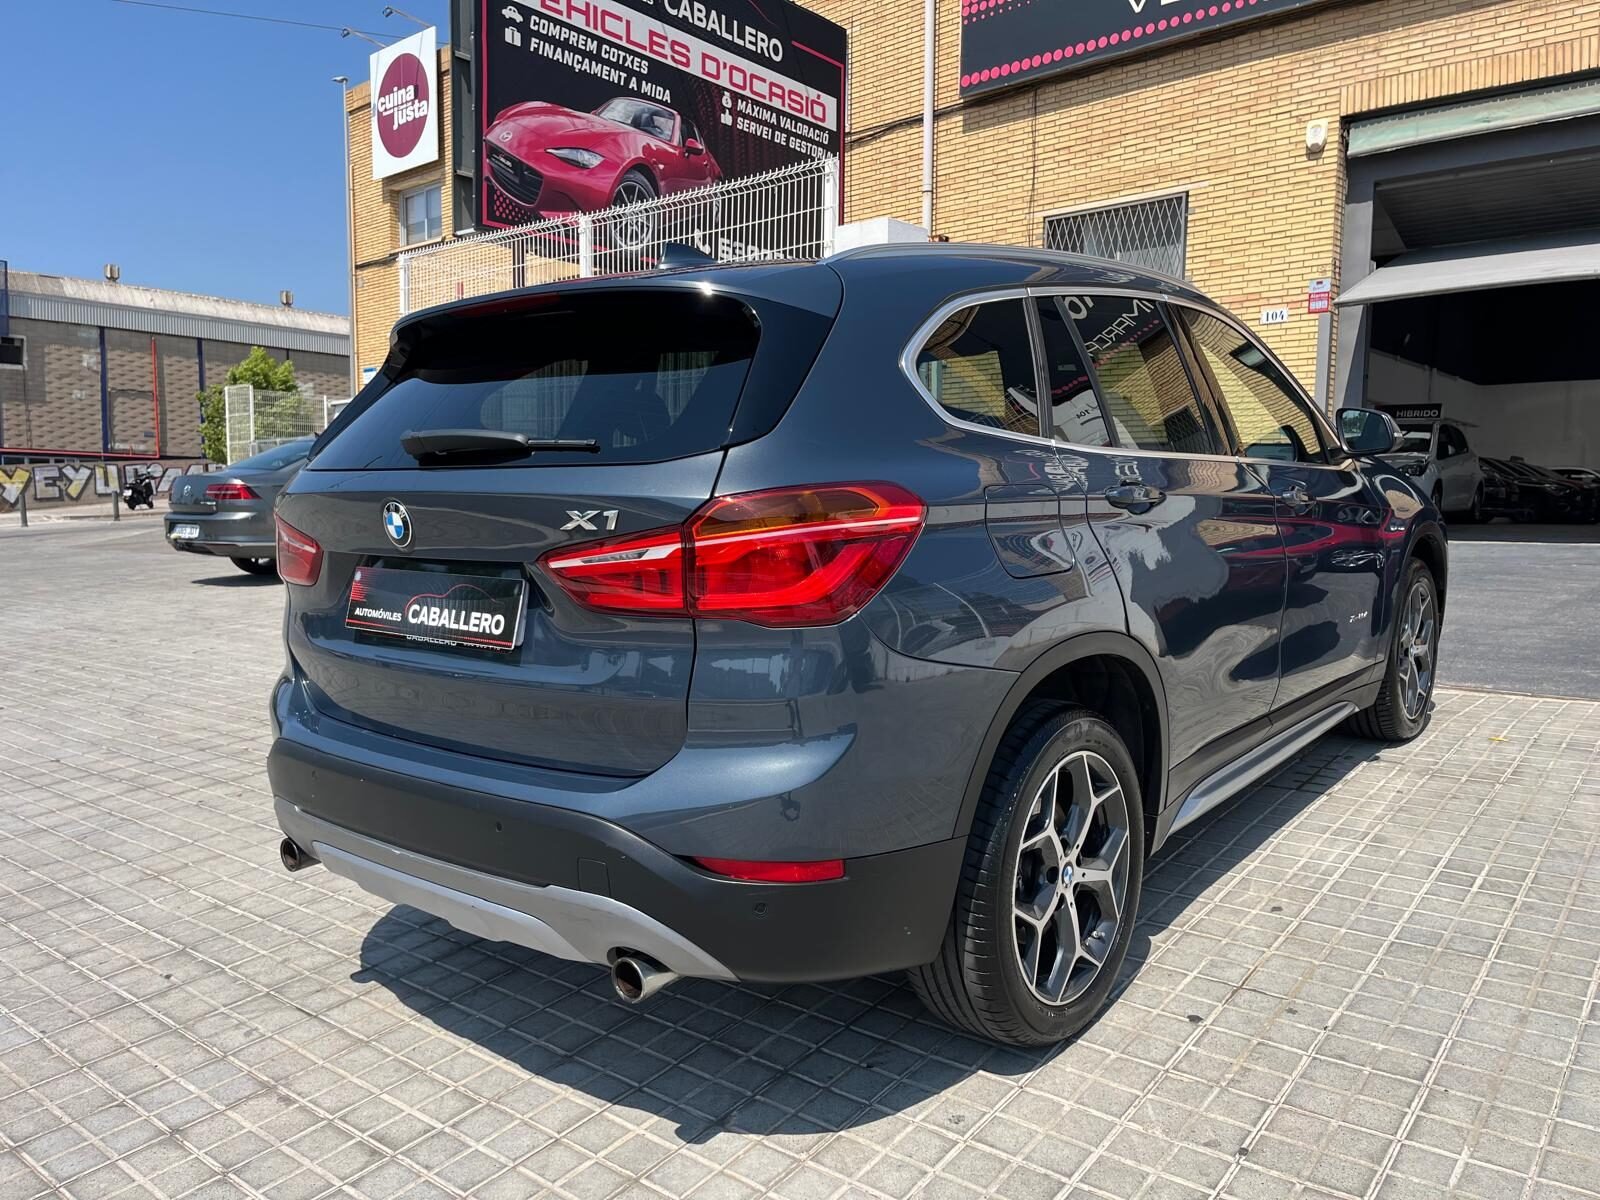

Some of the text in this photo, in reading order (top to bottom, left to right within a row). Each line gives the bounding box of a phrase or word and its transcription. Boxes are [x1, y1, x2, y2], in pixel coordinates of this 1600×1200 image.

[529, 15, 649, 74] COMPREM COTXES
[664, 0, 783, 62] CABALLERO
[530, 37, 671, 104] FINANÇAMENT A MIDA
[378, 84, 415, 112] cuina
[701, 52, 826, 123] D'OCASIÓ
[393, 99, 428, 131] justa
[737, 98, 829, 144] MÀXIMA VALORACIÓ
[737, 117, 772, 140] SERVEI
[774, 131, 787, 146] DE
[1266, 310, 1284, 322] 104
[559, 509, 619, 531] X1
[354, 604, 505, 636] AUTOMÓVILES CABALLERO
